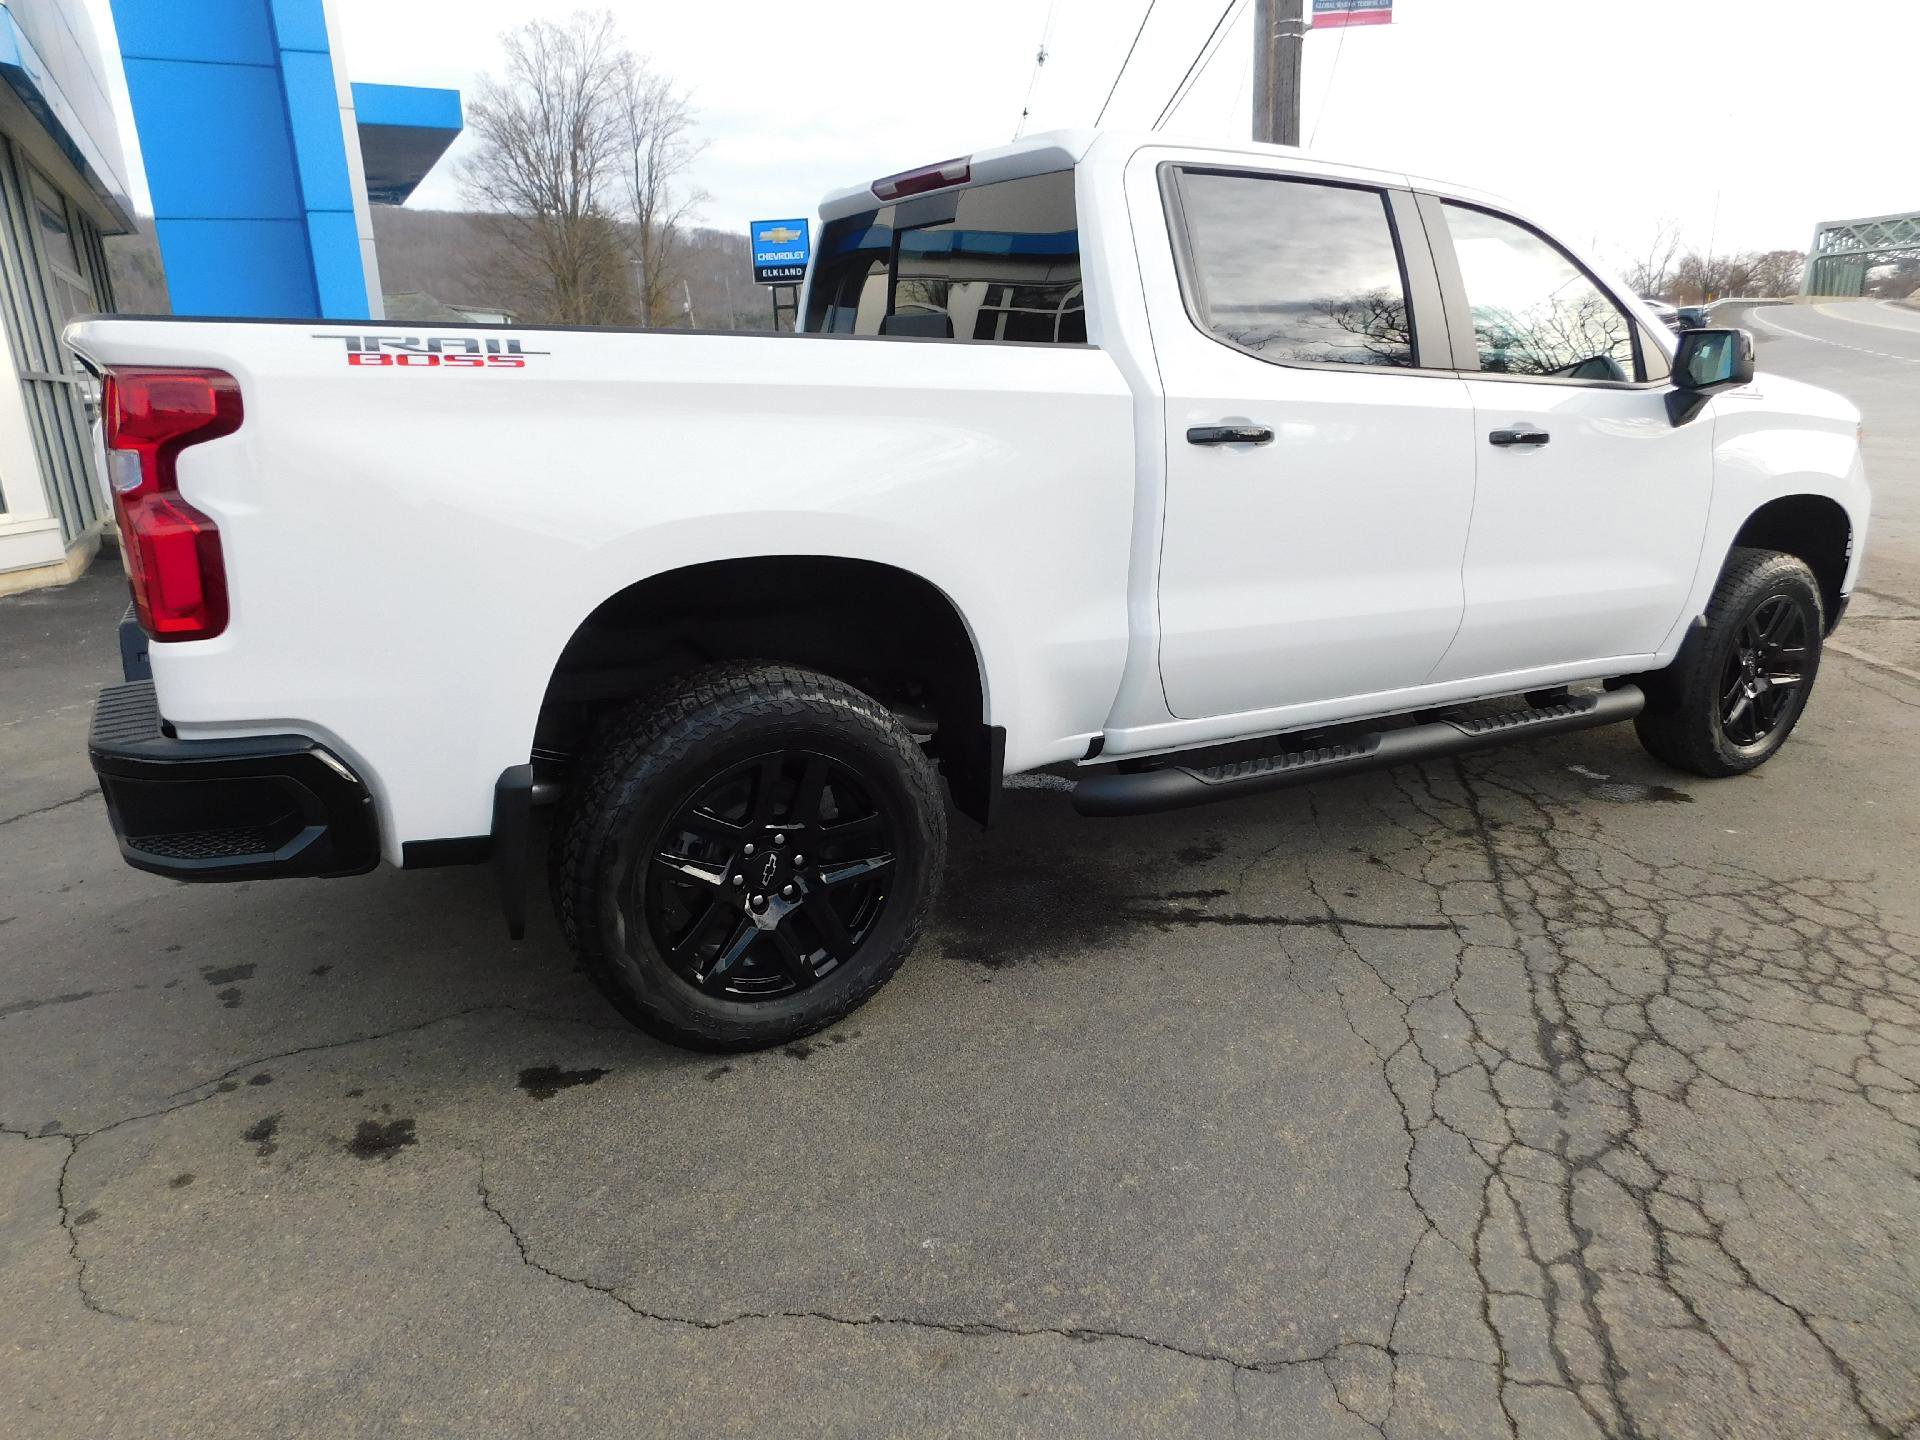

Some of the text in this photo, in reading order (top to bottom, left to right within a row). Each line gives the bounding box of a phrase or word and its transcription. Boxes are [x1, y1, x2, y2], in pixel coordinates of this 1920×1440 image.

[757, 251, 805, 261] CHEVROLET
[762, 268, 802, 277] ELKLAND
[311, 335, 551, 355] TRAIL
[347, 352, 526, 368] BOSS
